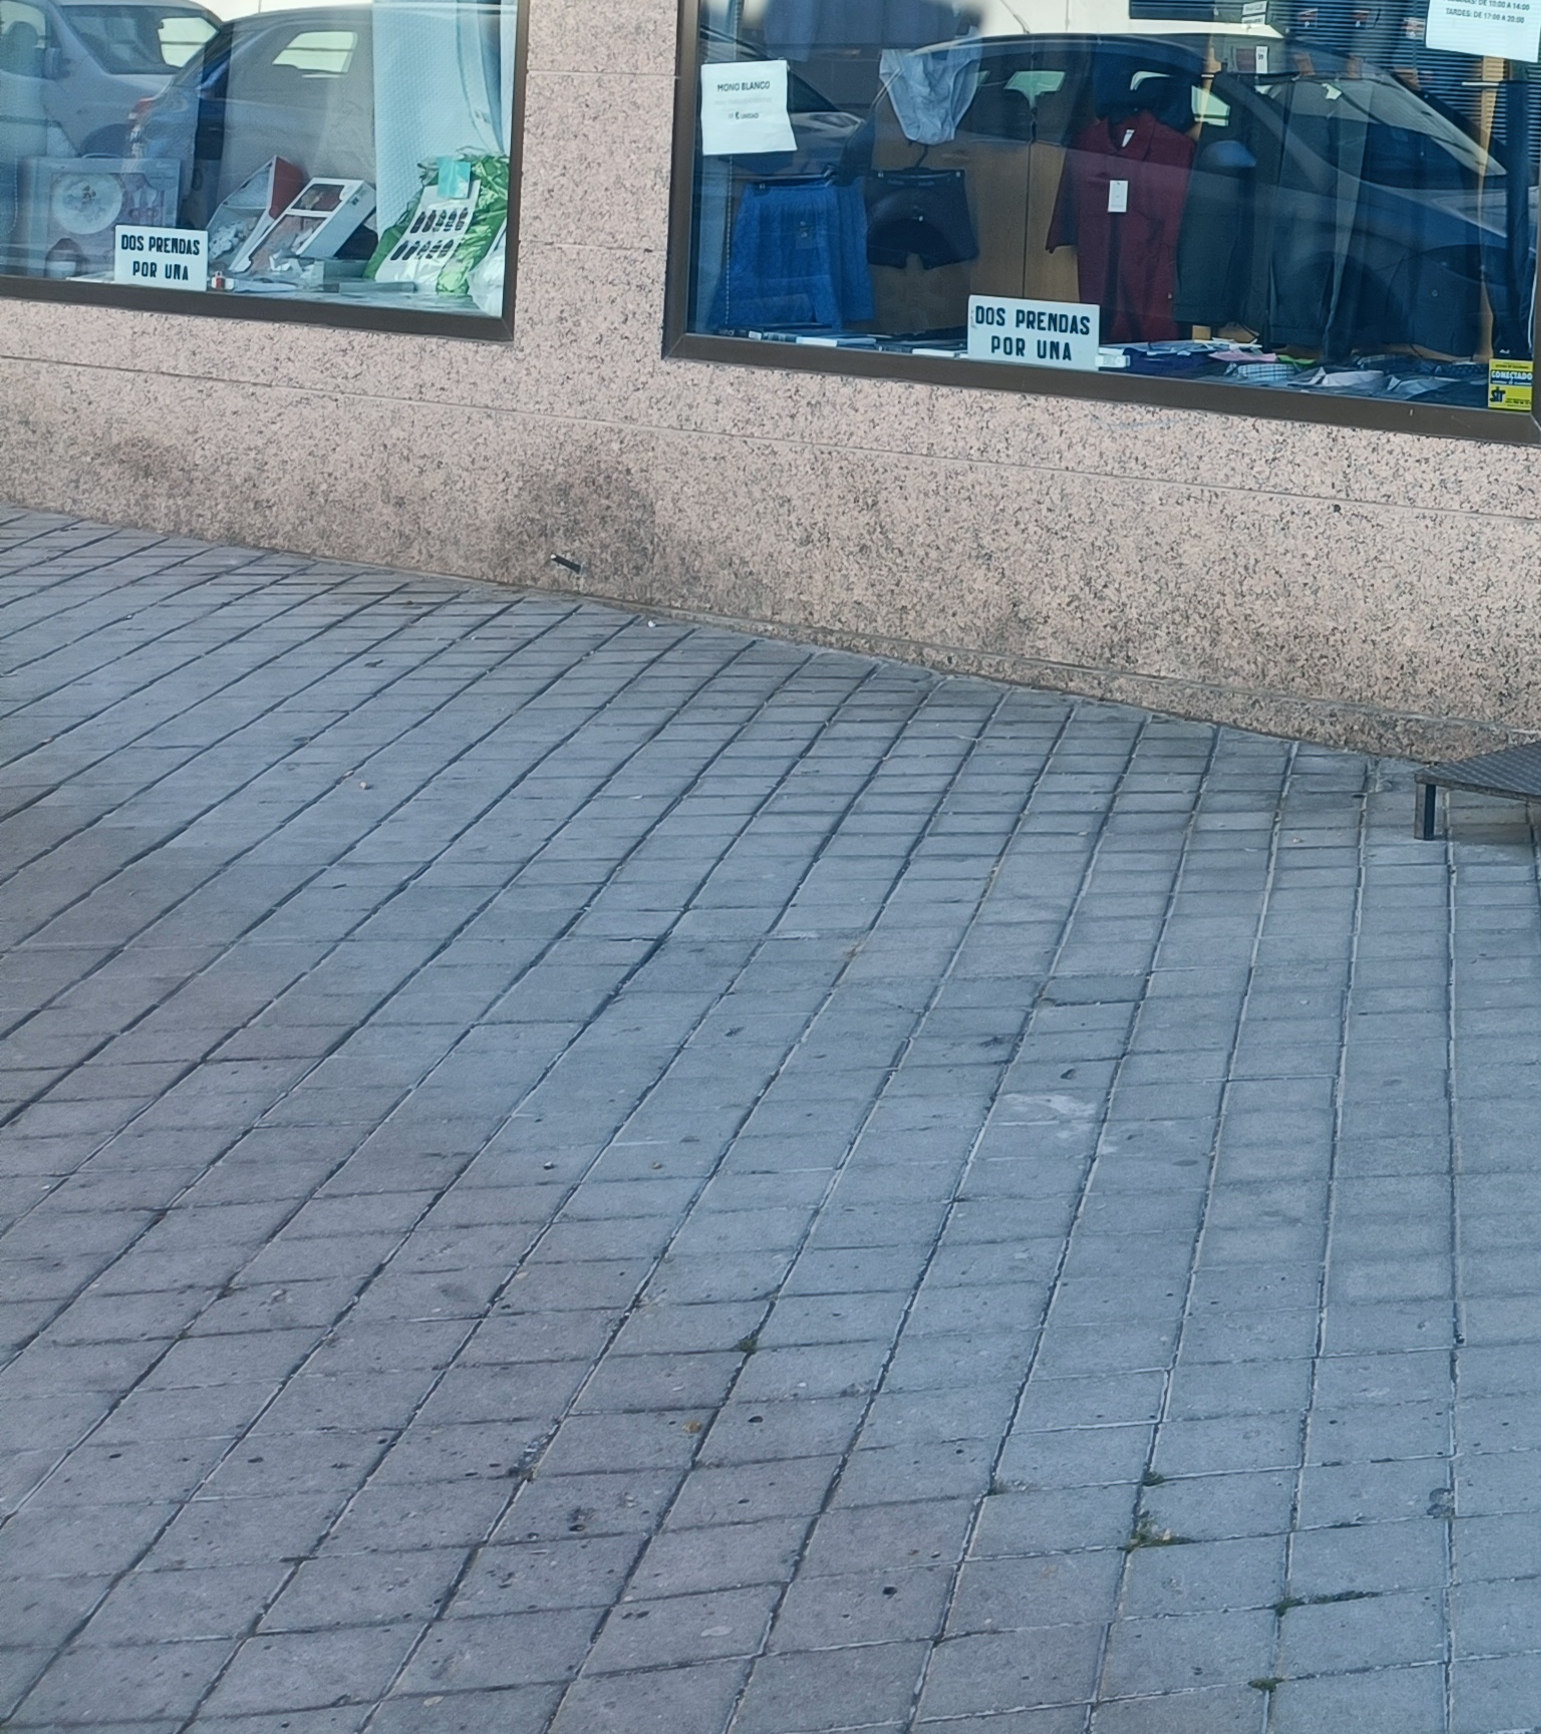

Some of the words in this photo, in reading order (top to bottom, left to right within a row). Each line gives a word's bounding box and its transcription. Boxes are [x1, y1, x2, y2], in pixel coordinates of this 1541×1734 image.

[1478, 0, 1487, 7] DE
[717, 82, 740, 92] MONO
[741, 81, 770, 91] BLANCO
[121, 234, 144, 251] DOS
[148, 236, 200, 255] PRENDAS
[132, 261, 157, 278] POR
[165, 264, 189, 281] UNA
[975, 305, 1006, 326] DOS
[1016, 309, 1090, 335] PRENDAS
[991, 335, 1026, 357] POR
[1037, 339, 1072, 361] UNA
[1491, 370, 1533, 381] CONECTADO
